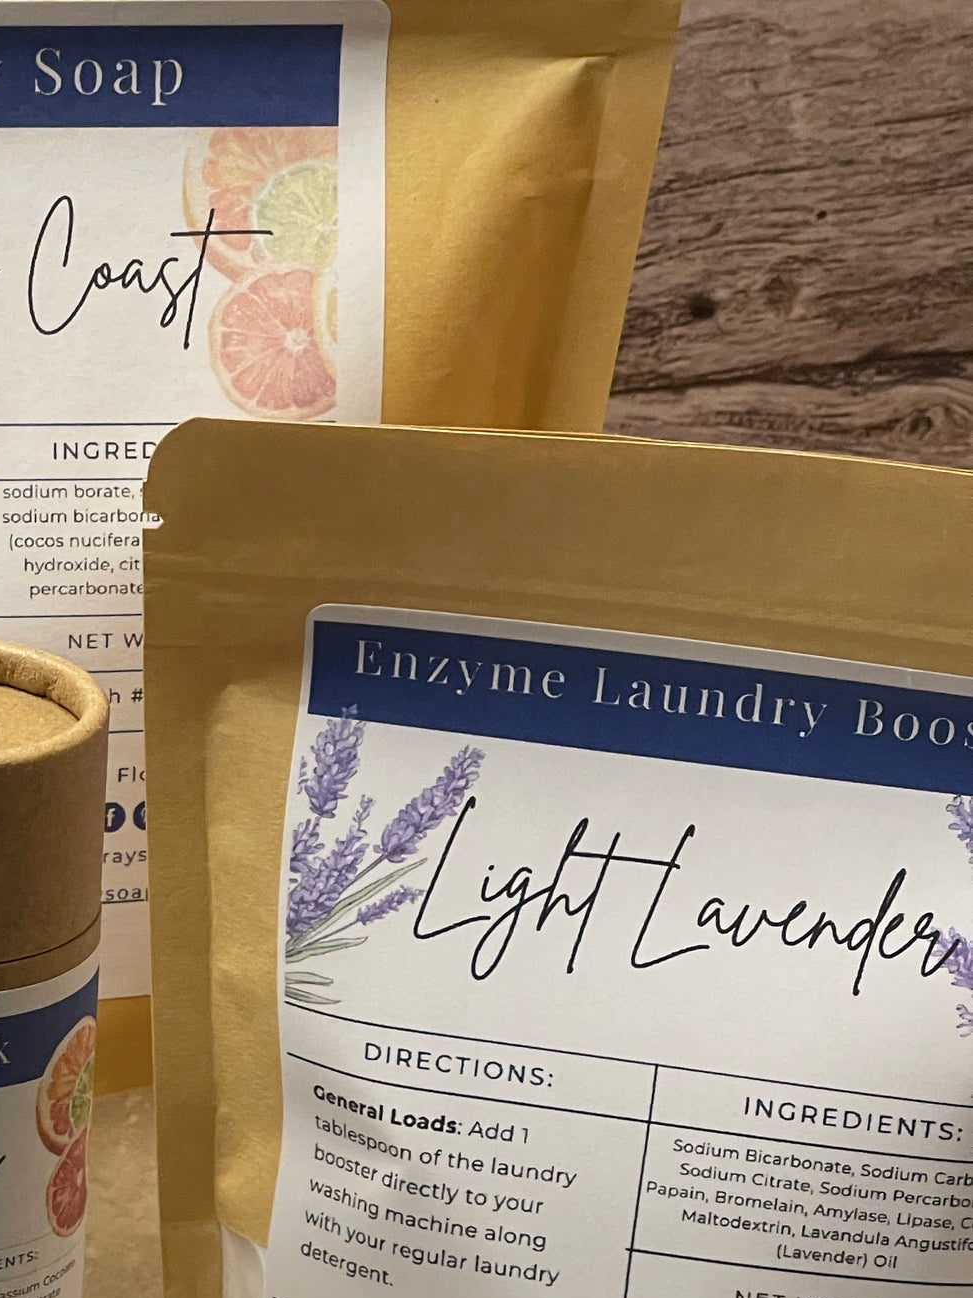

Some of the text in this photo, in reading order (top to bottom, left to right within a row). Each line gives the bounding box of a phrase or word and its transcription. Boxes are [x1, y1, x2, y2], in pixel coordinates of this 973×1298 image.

[35, 49, 182, 105] Soap
[28, 195, 273, 350] Coast
[3, 485, 67, 498] sodium
[75, 485, 134, 498] borate,
[3, 509, 67, 523] sodium
[10, 533, 140, 550] (cocos nucifera
[24, 557, 113, 575] hydroxide,
[69, 633, 113, 649] NET
[357, 641, 564, 698] Enzyme
[594, 668, 827, 737] Laundry
[413, 796, 961, 996] Light Lavender
[365, 1043, 553, 1087] DIRECTIONS:
[313, 1085, 528, 1143] General Loads: Add 1
[745, 1095, 962, 1141] INGREDIENTS:
[314, 1115, 577, 1188] tablespoon of the laundry
[673, 1139, 739, 1159] Sodium
[746, 1149, 854, 1176] Bicarbonate,
[861, 1164, 927, 1182] Sodium
[314, 1143, 543, 1219] booster directly to your
[680, 1163, 973, 1207] Sodium Citrate, Sodium Percarbo
[310, 1178, 546, 1252] washing machine along
[647, 1181, 708, 1203] Papain,
[715, 1191, 807, 1216] Bromelain,
[813, 1204, 890, 1225] Amylase,
[897, 1213, 954, 1230] Lipase,
[682, 1208, 795, 1237] Maltodextrin,
[801, 1225, 889, 1245] Lavandula
[300, 1240, 395, 1288] detergent.
[305, 1209, 559, 1286] with your regular laundry
[777, 1244, 897, 1268] (Lavender) Oil
